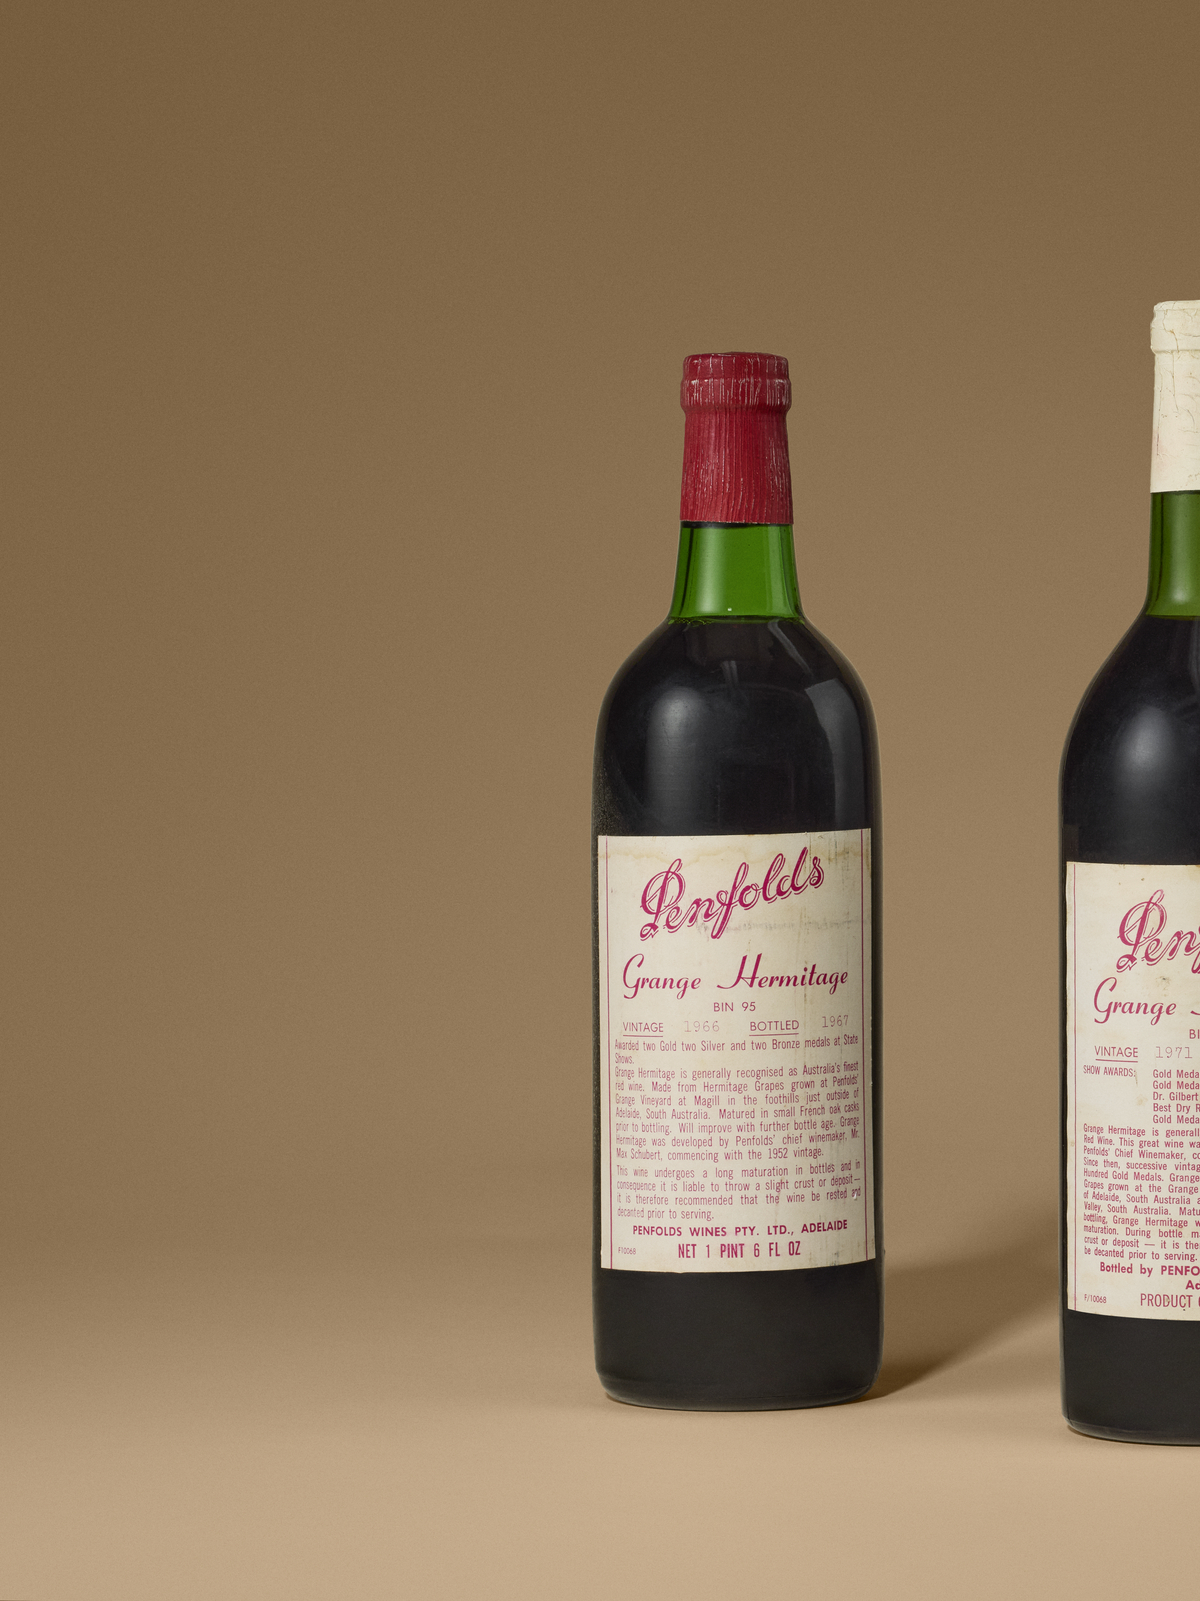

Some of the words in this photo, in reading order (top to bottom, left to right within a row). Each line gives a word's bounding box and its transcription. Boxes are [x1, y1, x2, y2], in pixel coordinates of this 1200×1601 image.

[640, 847, 824, 941] Penfolds
[623, 953, 701, 1000] Grange
[716, 953, 848, 995] Hermitage
[714, 1002, 733, 1012] BIN
[742, 1002, 756, 1011] 95
[1094, 977, 1176, 1025] Grange
[623, 1022, 663, 1032] VINTAGE
[685, 1021, 719, 1032] 1966
[750, 1020, 799, 1031] BOTTLED
[823, 1015, 848, 1028] 1967
[615, 1039, 639, 1051] Awarded
[643, 1041, 656, 1051] two
[660, 1040, 676, 1051] Gold
[682, 1041, 696, 1051] two
[701, 1040, 725, 1051] Silver
[731, 1040, 746, 1051] and
[751, 1040, 767, 1050] two
[772, 1039, 800, 1050] Bronze
[805, 1036, 830, 1048] medals
[834, 1036, 840, 1046] at
[844, 1034, 858, 1045] State
[615, 1053, 634, 1064] Shows.
[1095, 1046, 1138, 1058] VINTAGE
[1156, 1046, 1192, 1059] 1971
[615, 1069, 634, 1080] Grange
[638, 1068, 675, 1081] Hermitage
[680, 1068, 687, 1078] is
[692, 1068, 731, 1081] generally
[737, 1067, 783, 1080] recognised
[789, 1068, 797, 1076] as
[803, 1063, 840, 1075] Australia's
[844, 1061, 858, 1073] finest
[1083, 1065, 1100, 1075] SHOW
[1104, 1067, 1135, 1077] AWARDS:
[1153, 1069, 1171, 1078] Gold
[1153, 1080, 1171, 1089] Gold
[1153, 1091, 1164, 1100] Dr.
[1169, 1092, 1198, 1101] Gilbert
[1153, 1103, 1171, 1112] Best
[1176, 1104, 1190, 1114] Dry
[1153, 1114, 1171, 1123] Gold
[616, 1148, 627, 1158] Max
[631, 1148, 662, 1161] Schubert,
[668, 1149, 719, 1163] commencing
[724, 1150, 742, 1160] with
[748, 1149, 762, 1160] the
[769, 1148, 788, 1159] 1952
[793, 1147, 823, 1158] vintage.
[633, 1225, 682, 1236] PENFOLDS
[689, 1227, 727, 1237] WINES
[735, 1226, 759, 1236] PTY.
[767, 1225, 793, 1236] LTD.,
[801, 1219, 847, 1233] ADELAIDE
[678, 1244, 697, 1258] NET
[706, 1244, 710, 1258] 1
[720, 1243, 746, 1258] PINT
[753, 1243, 760, 1257] 6
[769, 1242, 781, 1257] FL
[788, 1241, 801, 1256] OZ
[1084, 1245, 1091, 1255] be
[1094, 1247, 1124, 1258] decanted
[1129, 1250, 1147, 1260] prior
[1151, 1251, 1160, 1260] to
[1164, 1252, 1197, 1262] serving.
[1100, 1262, 1133, 1274] Bottled
[1140, 1264, 1153, 1277] by
[1084, 1294, 1106, 1303] F/10068
[1140, 1293, 1193, 1308] PRODUCT
